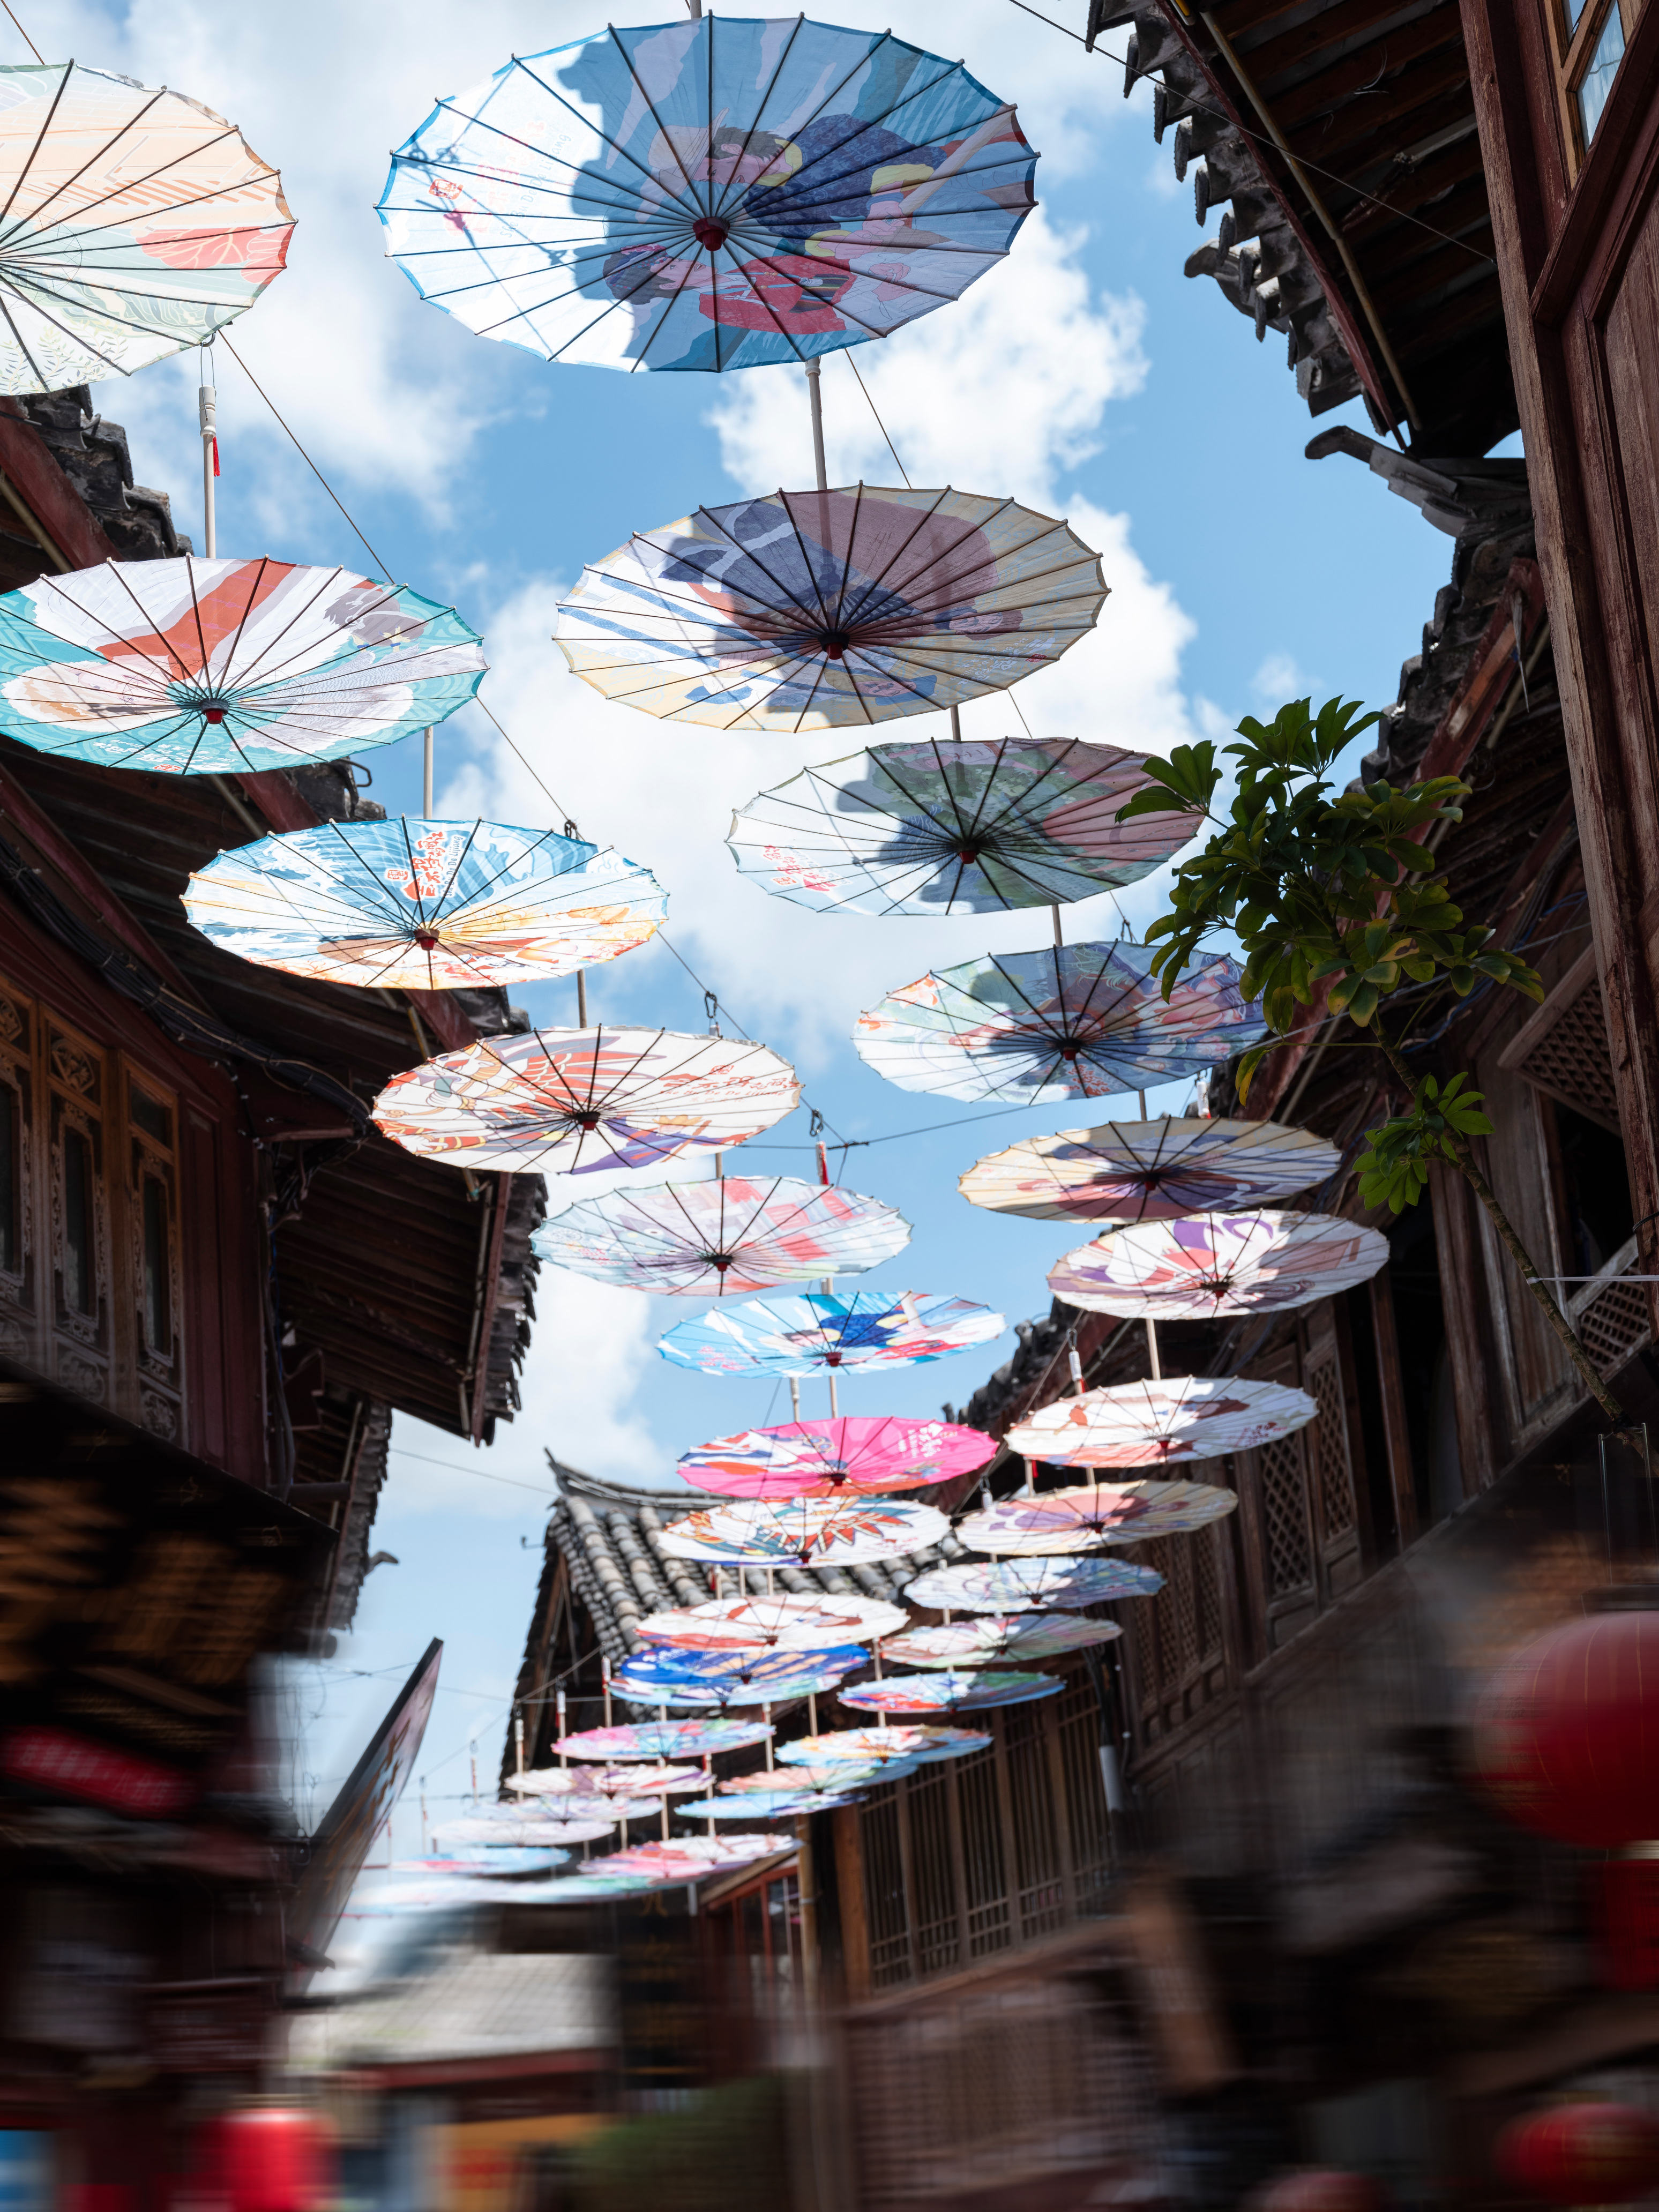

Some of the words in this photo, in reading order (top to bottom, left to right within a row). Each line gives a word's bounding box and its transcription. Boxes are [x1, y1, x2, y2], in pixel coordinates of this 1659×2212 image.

[499, 221, 520, 238] She
[511, 203, 528, 219] Bu
[520, 189, 538, 204] De
[529, 172, 547, 188] De
[1013, 637, 1029, 646] She
[449, 836, 464, 856] Lijiang
[403, 832, 445, 900] 舍不得的丽江
[446, 868, 456, 876] De
[448, 858, 458, 866] De
[763, 845, 838, 892] 舍不得的丽江
